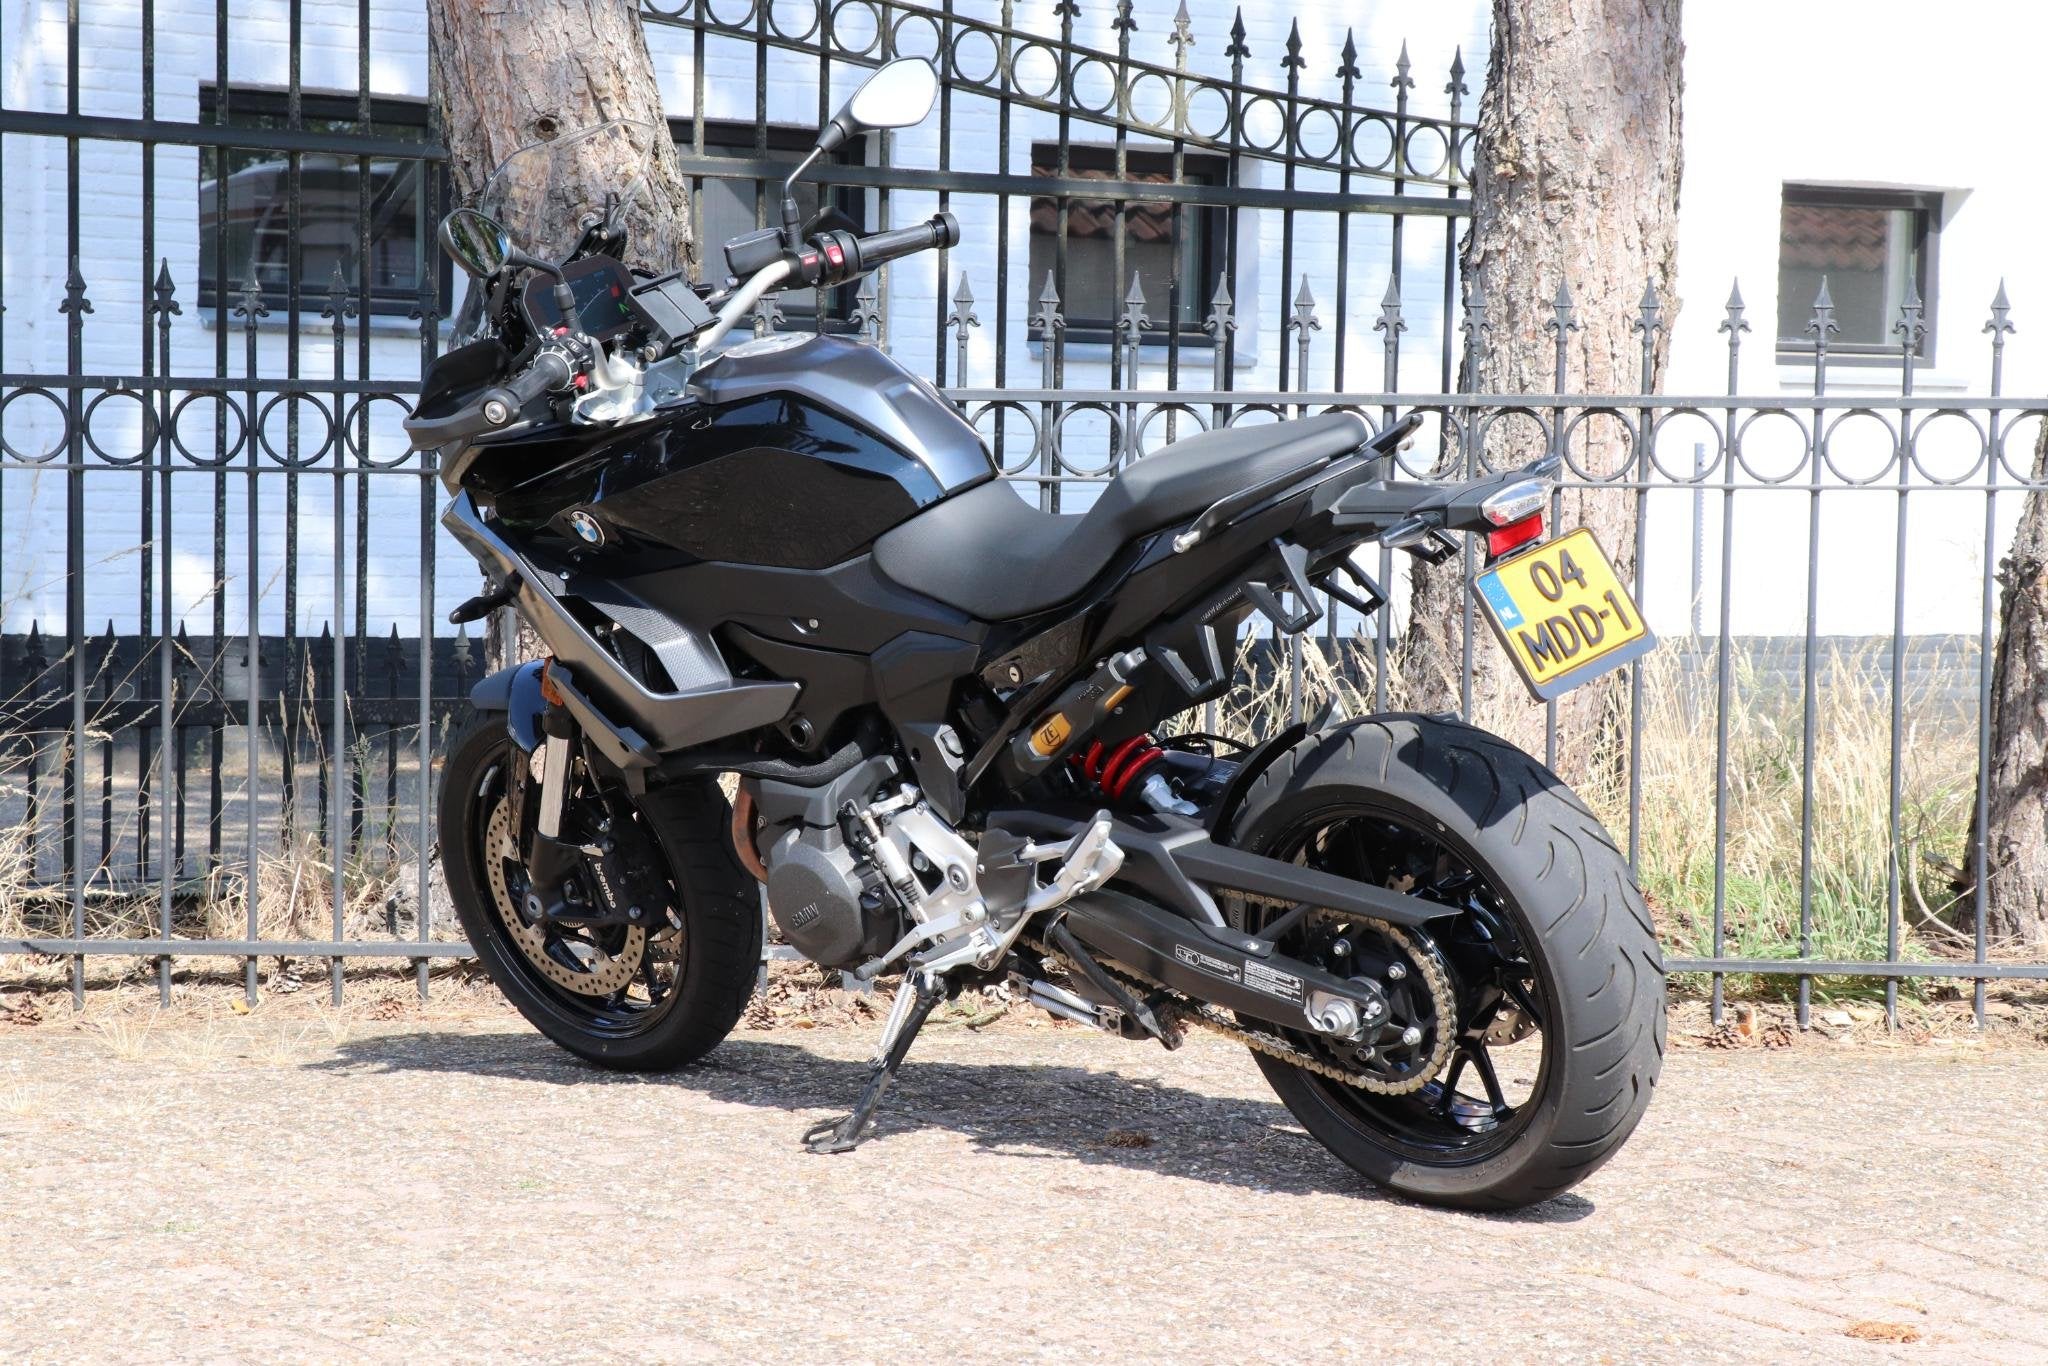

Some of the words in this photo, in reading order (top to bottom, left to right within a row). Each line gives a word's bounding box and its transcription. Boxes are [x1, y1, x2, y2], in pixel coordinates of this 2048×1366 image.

[1529, 548, 1588, 602] 04
[1499, 606, 1518, 621] NL
[1518, 589, 1633, 673] MDD-1
[594, 862, 617, 909] brembo
[791, 901, 820, 927] BMW
